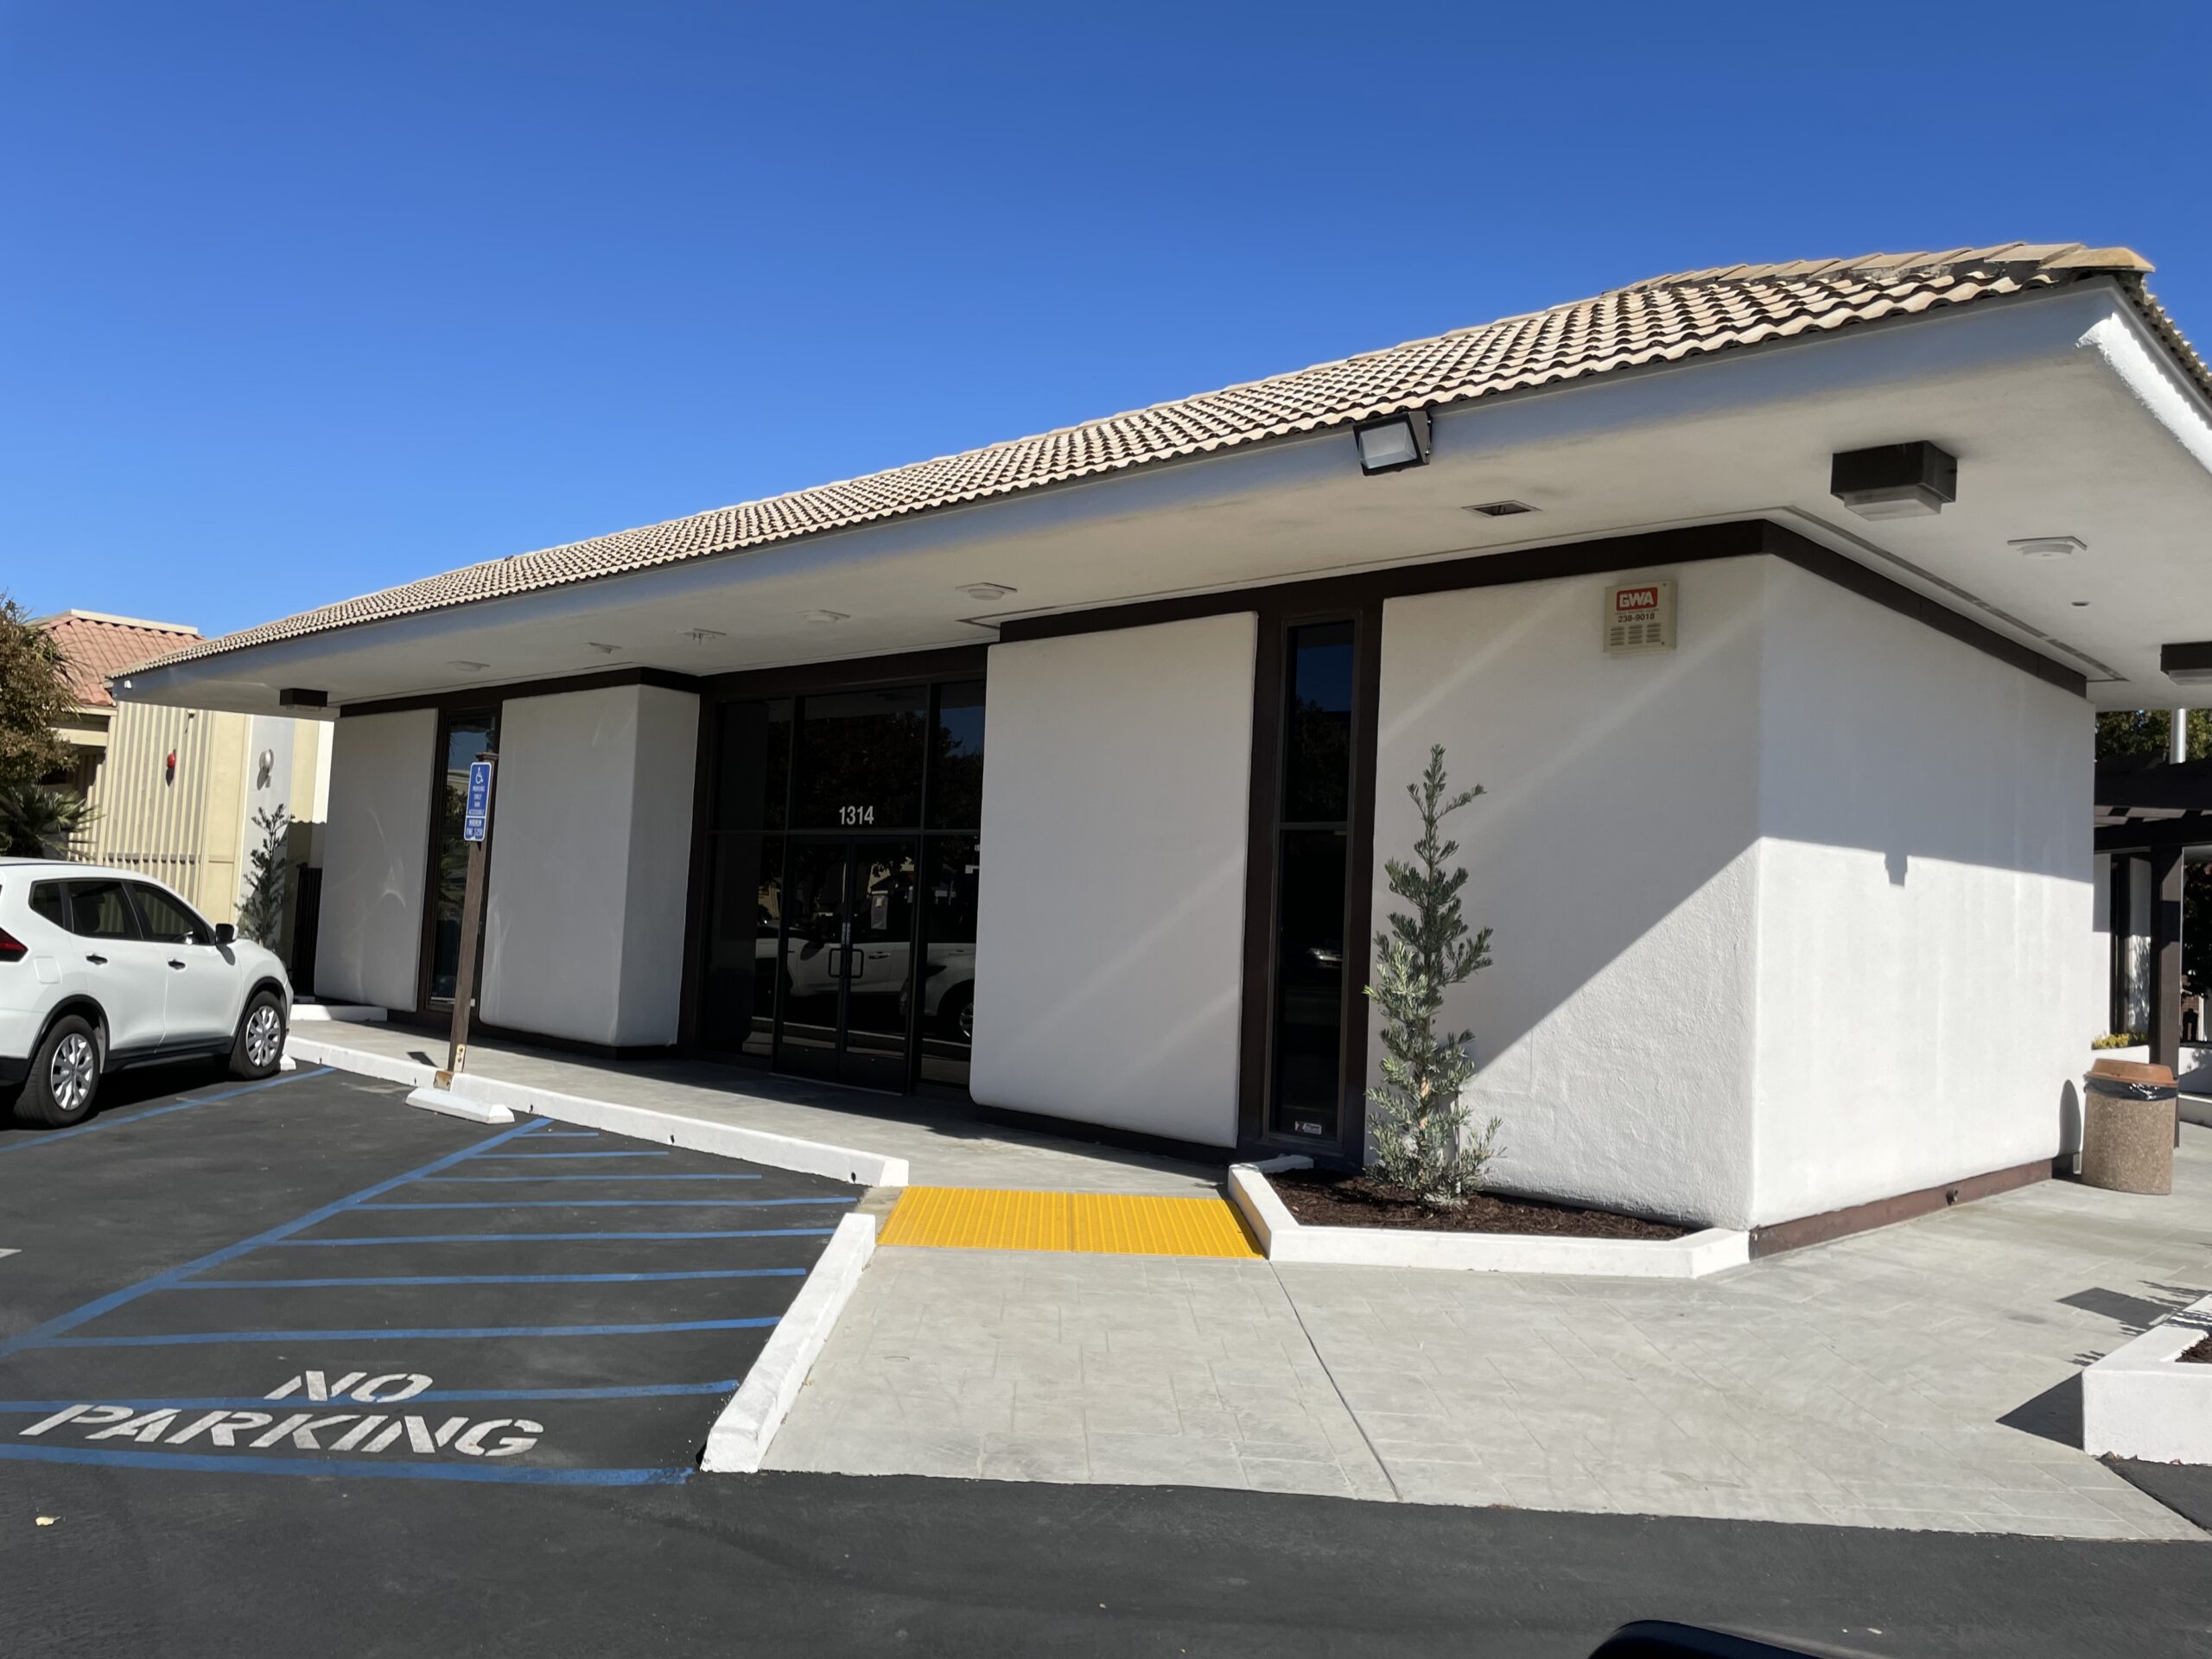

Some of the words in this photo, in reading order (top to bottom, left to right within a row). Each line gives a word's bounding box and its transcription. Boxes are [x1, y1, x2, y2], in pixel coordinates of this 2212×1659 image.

[1618, 612, 1655, 623] 238-9018
[839, 805, 874, 825] 1314
[263, 1370, 432, 1403] NO
[18, 1403, 543, 1457] PARKING
